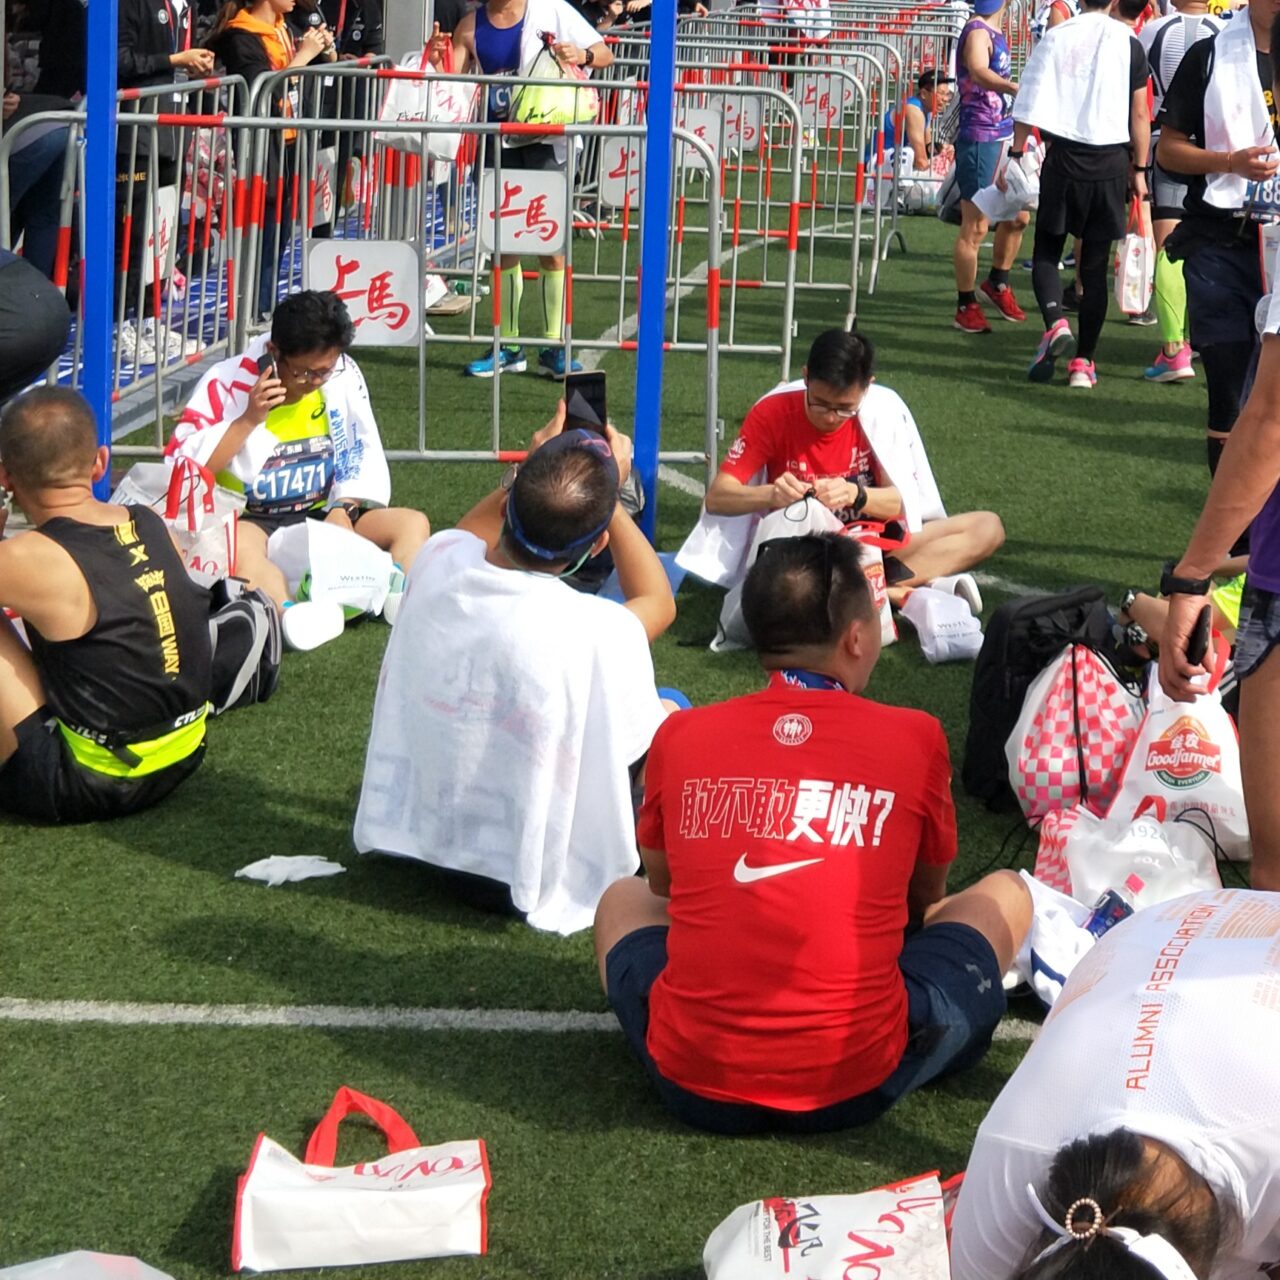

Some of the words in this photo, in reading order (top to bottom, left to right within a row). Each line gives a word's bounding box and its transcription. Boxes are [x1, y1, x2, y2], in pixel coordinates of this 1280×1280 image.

[252, 462, 326, 500] C17471
[1147, 748, 1220, 770] Goodfarmer
[680, 777, 896, 847] 敢不敢更快?
[1126, 1003, 1163, 1091] ALUMNI
